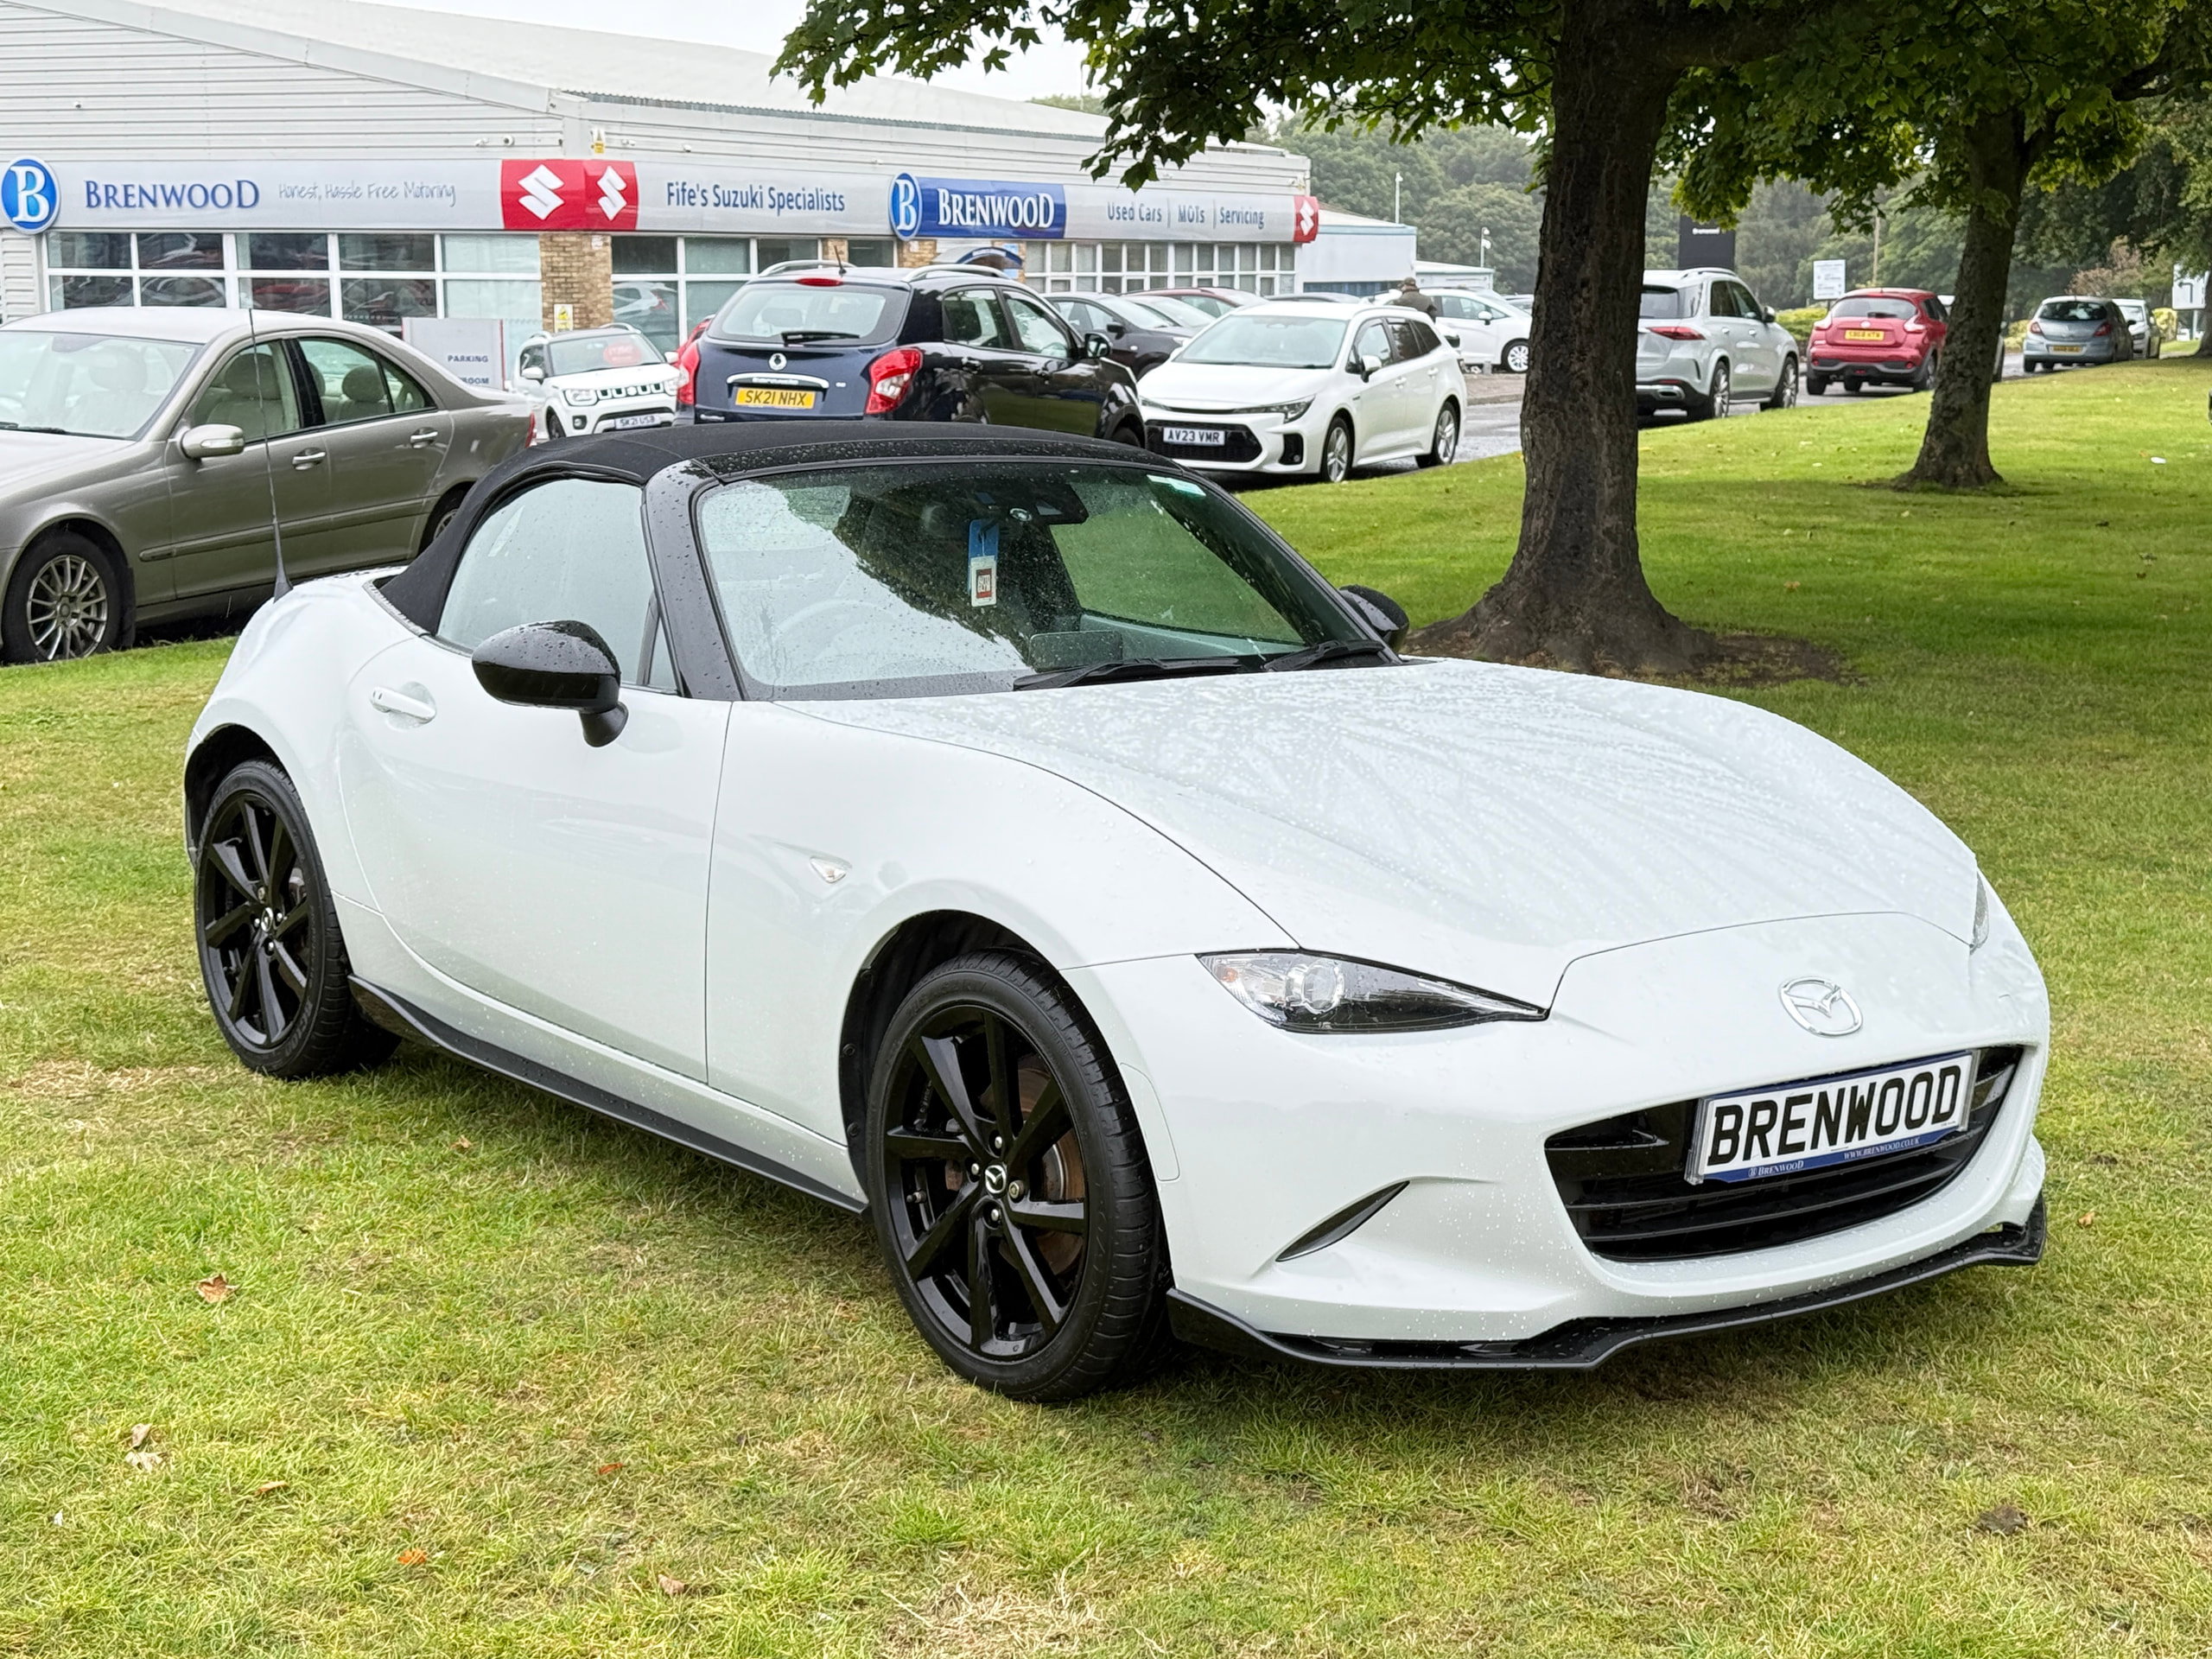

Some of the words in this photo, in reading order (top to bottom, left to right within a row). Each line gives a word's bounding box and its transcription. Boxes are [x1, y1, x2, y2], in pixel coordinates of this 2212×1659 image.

[85, 180, 260, 208] BRENWOOD
[278, 182, 322, 201] Honest,
[325, 180, 363, 199] Hassle
[367, 182, 399, 199] Free
[404, 181, 457, 208] Motoring
[666, 182, 708, 207] Fife's
[713, 184, 764, 210] Suzuki
[768, 187, 845, 216] Specialists
[938, 188, 1054, 229] BRENWOOD
[1107, 201, 1135, 221] Used
[1139, 203, 1162, 223] Cars
[1178, 205, 1205, 224] MOTs
[1219, 207, 1264, 230] Servicing
[448, 354, 489, 363] PARKING
[746, 391, 775, 404] SK21
[778, 392, 807, 406] NHX
[1168, 429, 1195, 442] AV23
[1198, 431, 1220, 442] VMR
[1707, 1064, 1961, 1166] BRENWOOD
[1758, 1160, 1805, 1177] BRENWOOD
